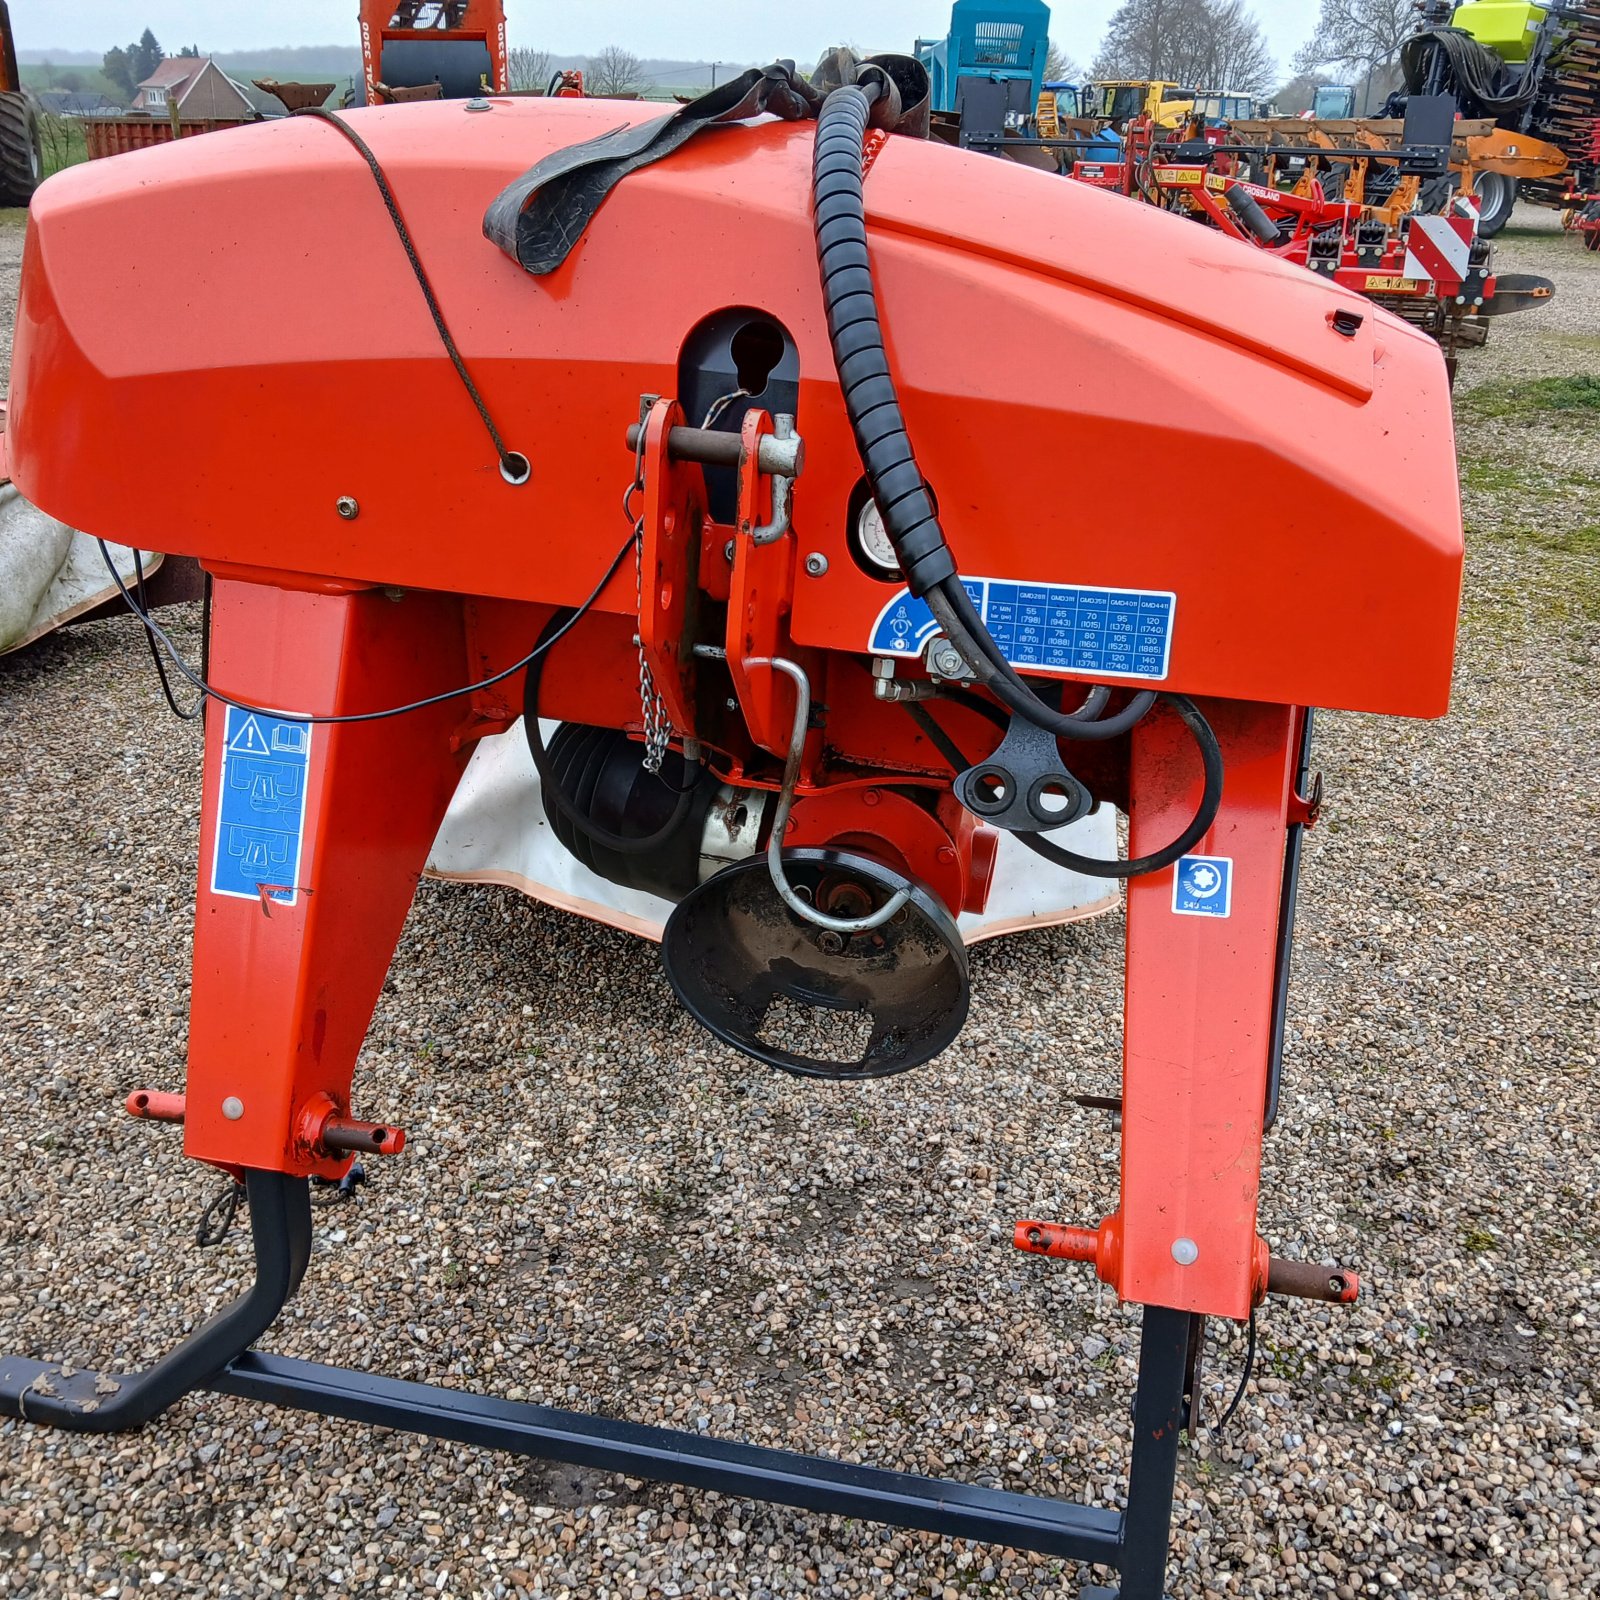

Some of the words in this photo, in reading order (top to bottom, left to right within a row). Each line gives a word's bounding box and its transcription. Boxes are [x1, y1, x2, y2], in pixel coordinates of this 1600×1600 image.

[362, 22, 372, 59] 3300
[1242, 185, 1280, 202] CROSSLAND
[1021, 616, 1040, 624] (798)
[1050, 618, 1071, 626] (943)
[1110, 623, 1132, 631] (1378)
